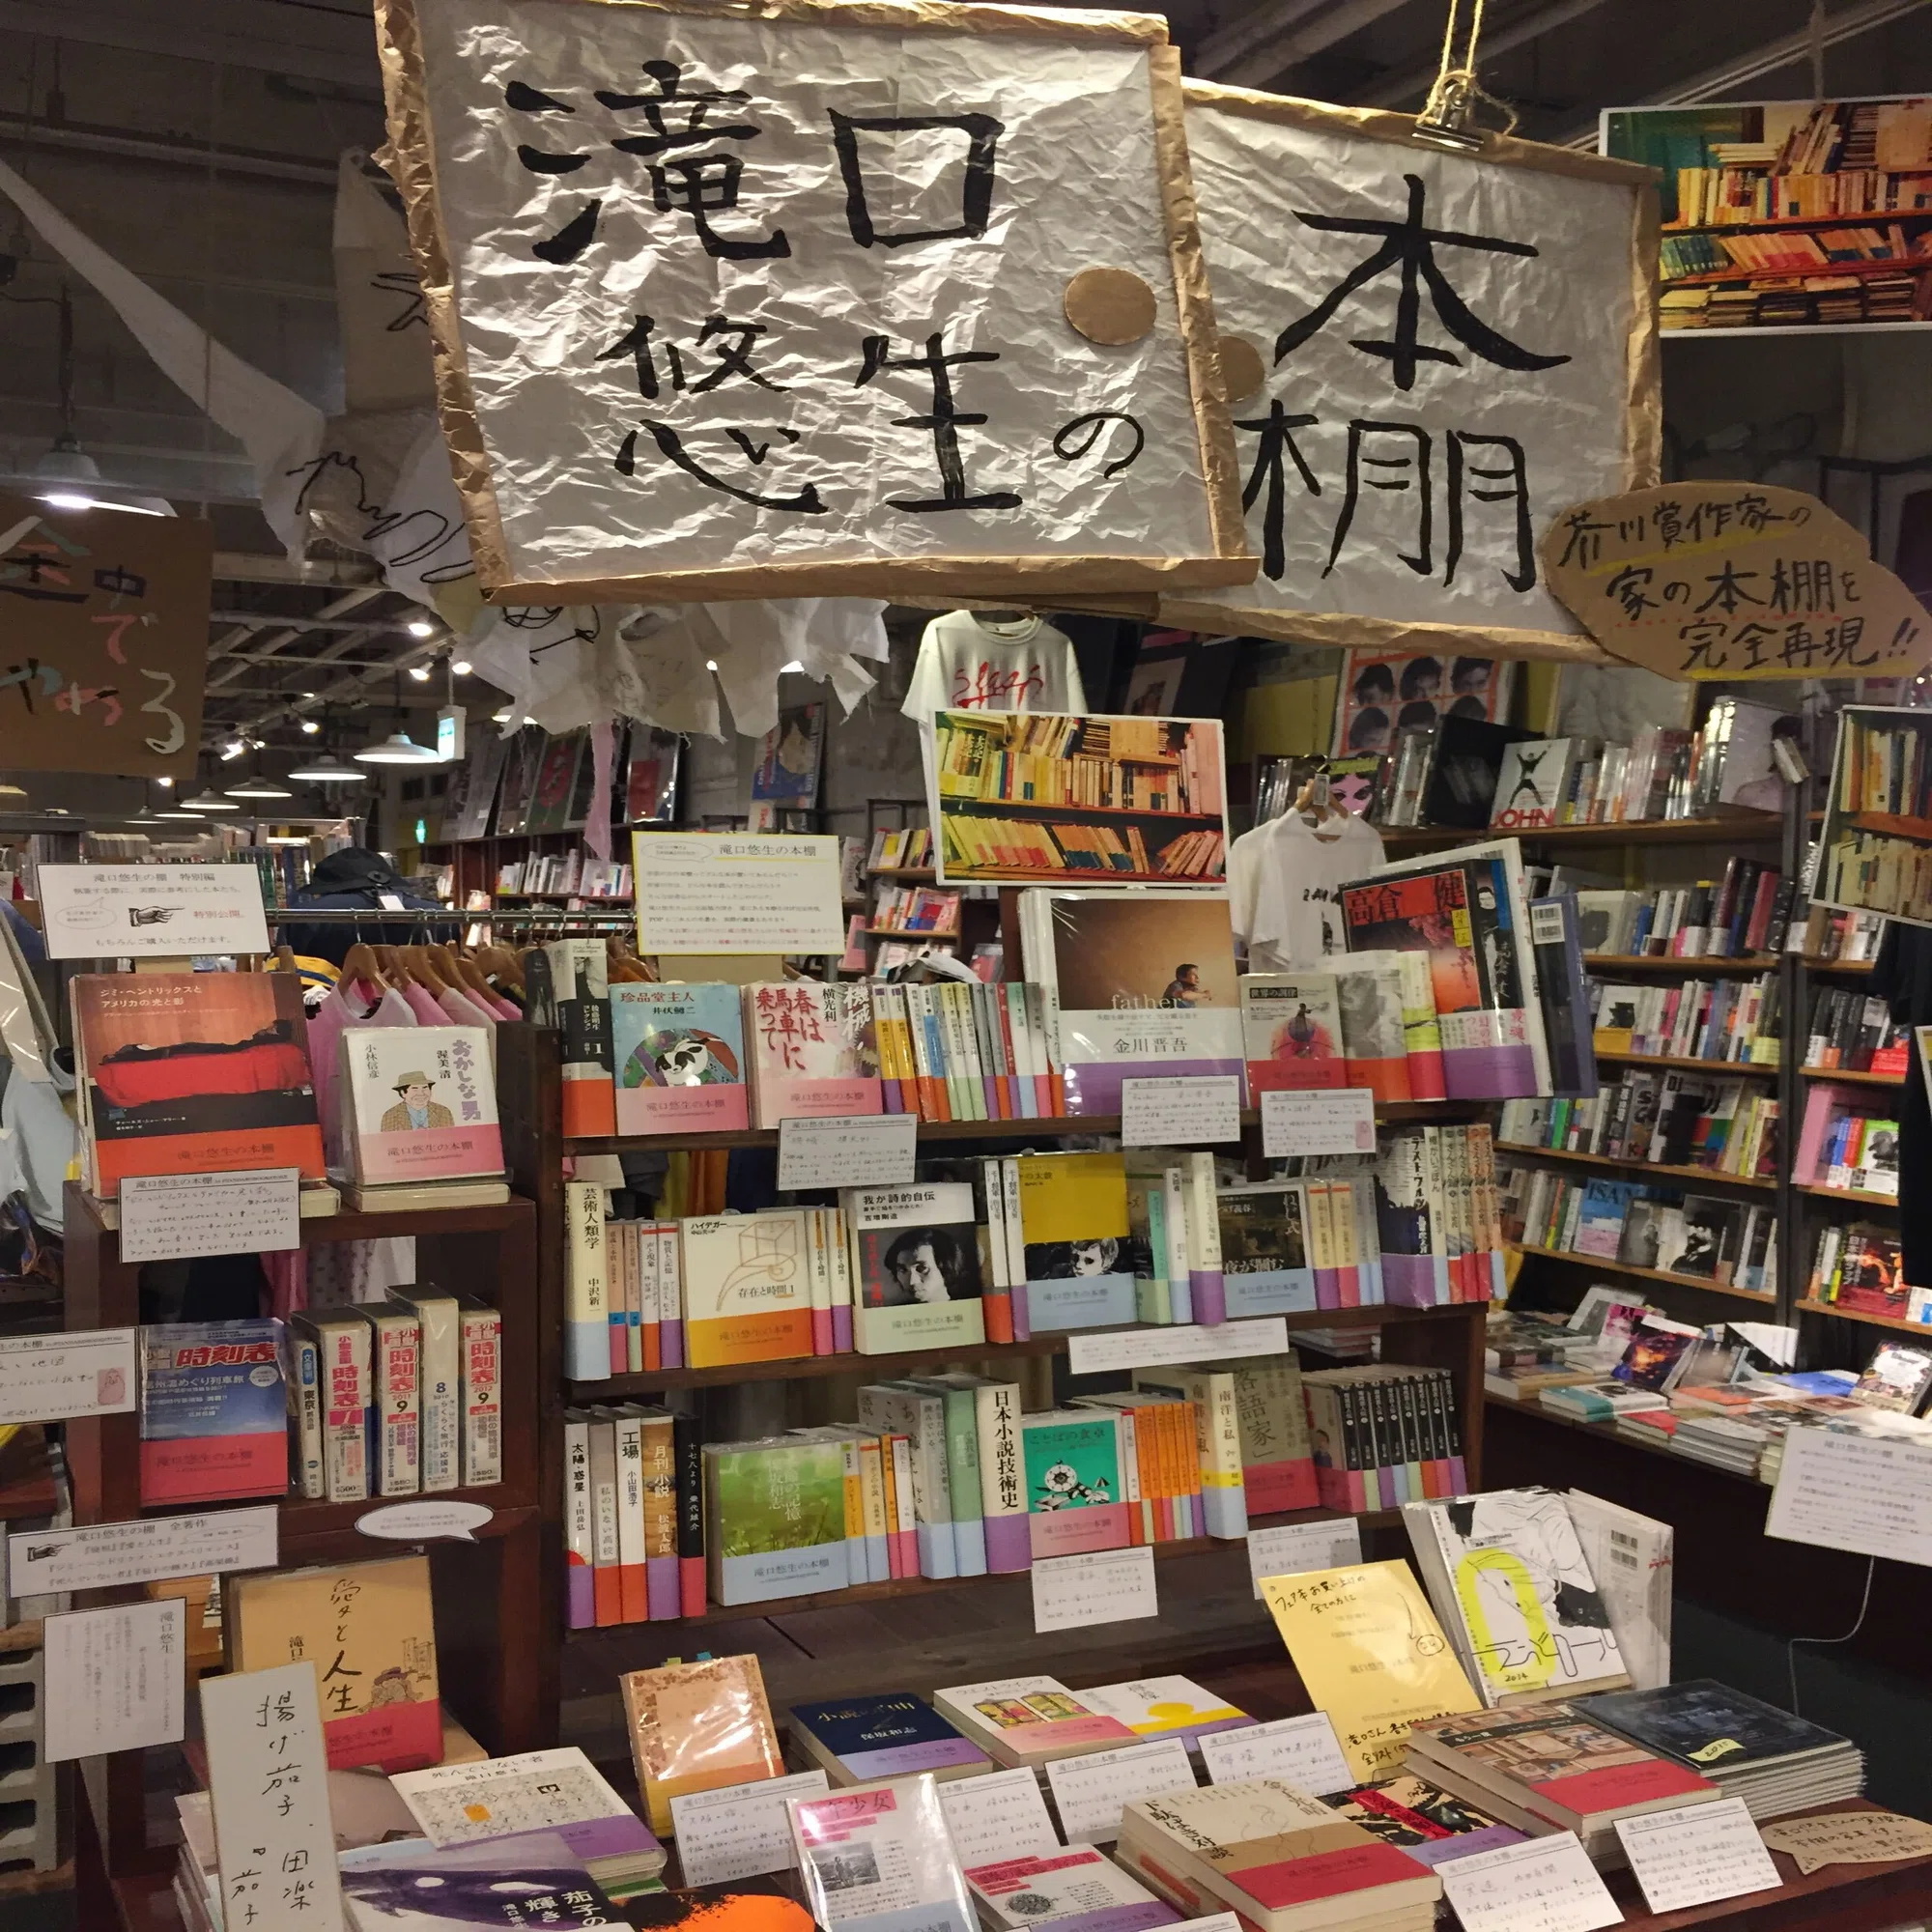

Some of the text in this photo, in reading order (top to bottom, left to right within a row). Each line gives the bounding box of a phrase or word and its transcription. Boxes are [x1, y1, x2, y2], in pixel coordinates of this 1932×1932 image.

[503, 59, 1004, 265] 滝口
[595, 314, 1146, 515] 悠生の
[1559, 497, 1811, 569] 芥川賞作家の
[1607, 559, 1862, 621] 家の本棚を
[719, 843, 816, 857] 滝口悠生の本棚
[94, 872, 215, 883] 滝口悠生の棚 特別編
[100, 985, 203, 998] ジミ・ヘンドリックスと
[100, 997, 185, 1009] アメリカの光と影
[620, 992, 695, 1003] 珍品堂主人
[822, 988, 838, 1029] 横光利一
[1111, 995, 1185, 1009] father
[364, 1044, 380, 1079] 小林信彦
[1113, 1037, 1187, 1053] 金川晋吾
[437, 1050, 451, 1079] 渥美清
[452, 1039, 481, 1121] おかしな男
[863, 1191, 935, 1205] 我が詩的自伝
[1283, 1193, 1300, 1235] ねじ式
[582, 1188, 600, 1250] 芸術人類学
[691, 1221, 727, 1230] ハイデガー
[588, 1278, 601, 1312] 中沢新一
[739, 1286, 786, 1298] 存在と時間
[176, 1342, 279, 1369] 時刻表
[389, 1349, 416, 1393] 時刻表
[470, 1342, 497, 1384] 時刻表
[332, 1365, 359, 1407] 時刻表
[436, 1382, 445, 1393] 8
[478, 1392, 489, 1405] 9
[397, 1401, 408, 1412] 9
[1220, 1390, 1235, 1440] 南洋と私
[622, 1432, 639, 1459] 工場
[688, 1442, 697, 1487] 十七八より
[993, 1391, 1019, 1509] 日本小説技術史
[572, 1443, 585, 1492] 太陽・惑星
[627, 1470, 638, 1507] 小山田浩子
[75, 1519, 208, 1543] 滝口悠生の棚 全著作
[601, 1487, 612, 1555] 私のいない高校
[658, 1514, 671, 1553] 松波太郎
[158, 1611, 175, 1655] 滝口悠生
[323, 1578, 362, 1713] 愛と人生
[256, 1691, 304, 1816] 揚げ茄子
